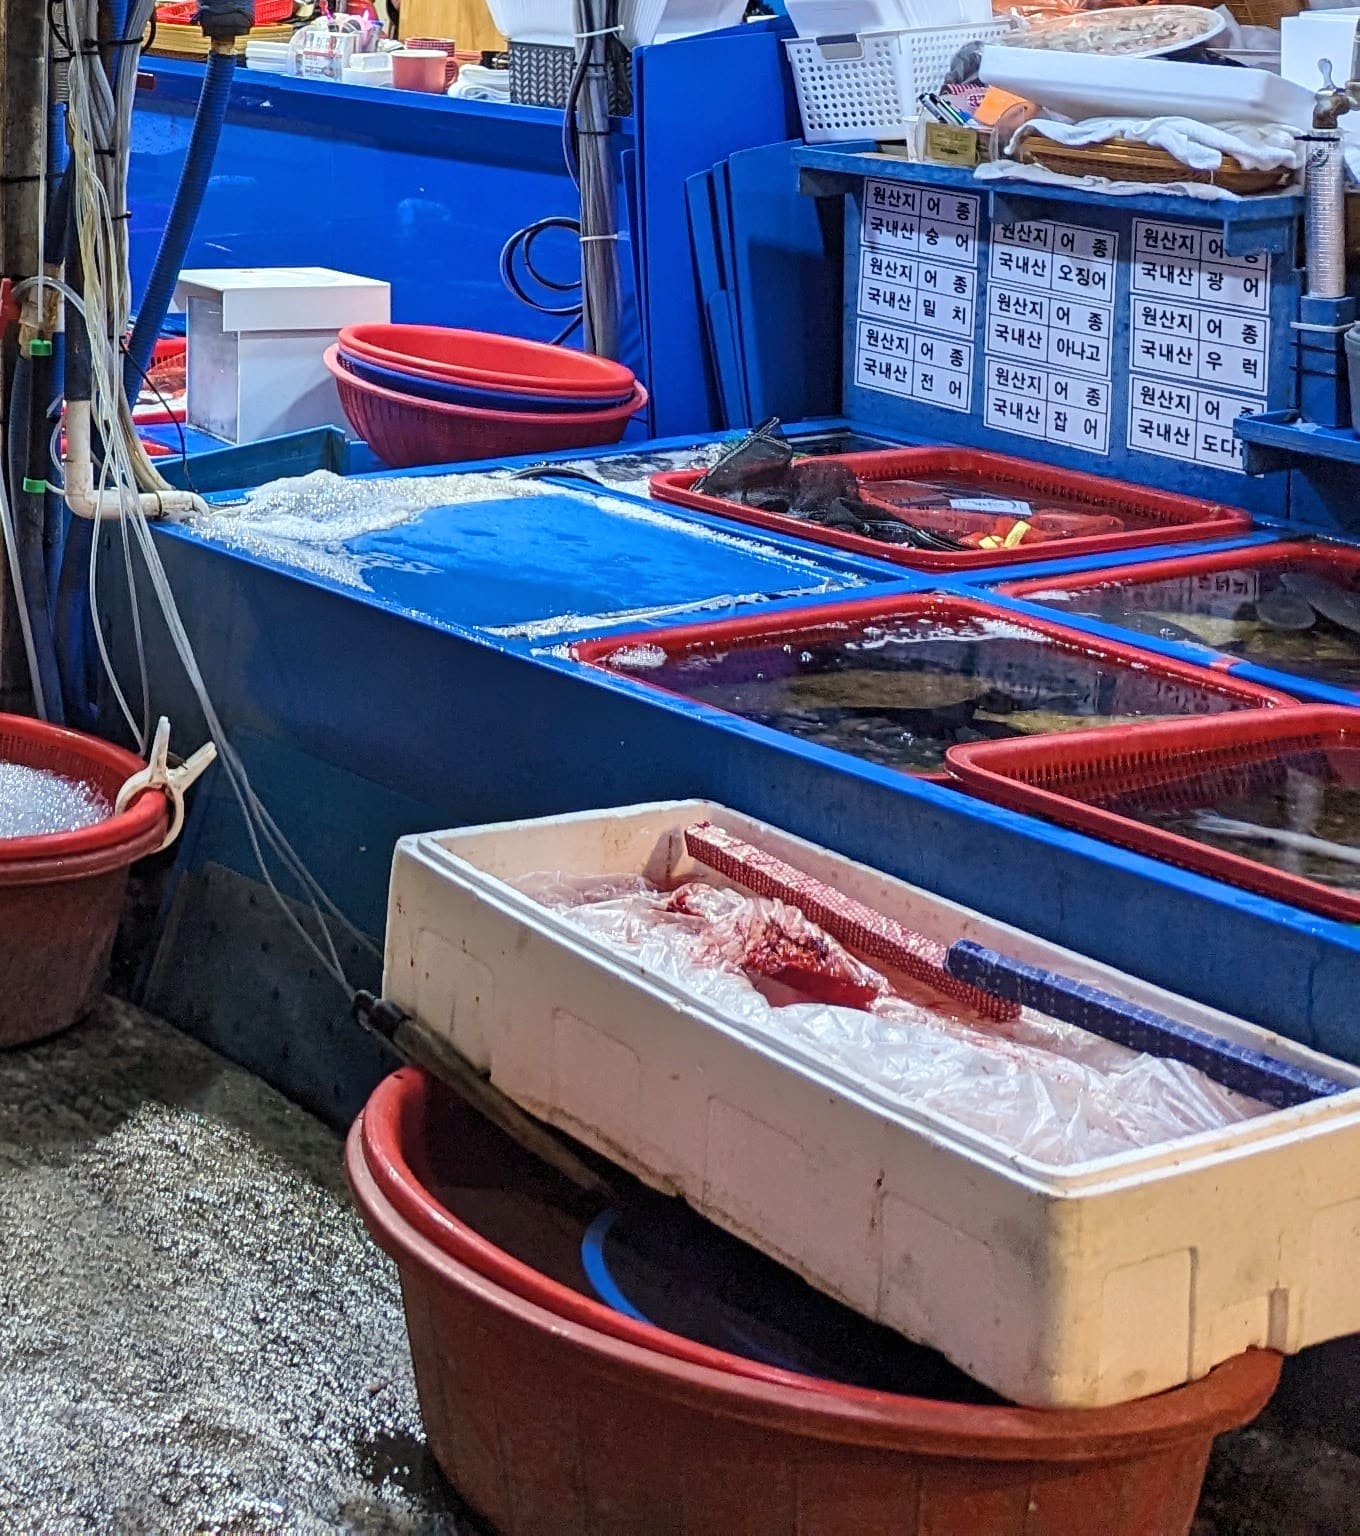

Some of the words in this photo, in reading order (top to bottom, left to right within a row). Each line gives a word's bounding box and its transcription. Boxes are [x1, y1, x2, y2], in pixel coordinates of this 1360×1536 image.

[872, 186, 916, 211] 원산지
[927, 197, 940, 215] 어
[956, 201, 970, 221] 종
[870, 217, 915, 240] 국내산
[925, 227, 939, 246] 숭
[955, 233, 969, 252] 어
[1060, 232, 1075, 251] 어
[1091, 238, 1108, 258] 종
[1143, 227, 1194, 254] 원산지
[1208, 238, 1224, 258] 어
[870, 257, 912, 282] 원산지
[924, 270, 937, 288] 어
[953, 275, 968, 294] 종
[998, 252, 1046, 277] 국내산
[1058, 264, 1107, 290] 오징어
[1141, 261, 1194, 286] 국내산
[1207, 271, 1224, 292] 광
[1243, 277, 1259, 298] 어
[867, 287, 911, 312] 국내산
[923, 299, 936, 317] 밀
[952, 307, 966, 325] 치
[997, 292, 1043, 319] 원산지
[1056, 307, 1071, 325] 어
[1087, 312, 1103, 332] 종
[994, 323, 1042, 349] 국내산
[1056, 338, 1101, 363] 아나고
[1142, 306, 1193, 333] 원산지
[1206, 319, 1222, 338] 어
[1241, 324, 1259, 345] 종
[865, 328, 909, 354] 원산지
[920, 342, 934, 360] 어
[949, 348, 964, 368] 종
[1140, 339, 1193, 365] 국내산
[1205, 351, 1223, 371] 우
[1242, 358, 1258, 379] 럭
[863, 357, 908, 383] 국내산
[920, 372, 934, 392] 전
[948, 380, 962, 399] 어
[995, 367, 1041, 394] 원산지
[1054, 382, 1068, 400] 어
[1085, 387, 1101, 407] 종
[993, 397, 1040, 424] 국내산
[1053, 412, 1068, 433] 잡
[1083, 418, 1098, 440] 어
[1140, 385, 1191, 413] 원산지
[1204, 400, 1220, 420] 어
[1138, 418, 1190, 446] 국내산
